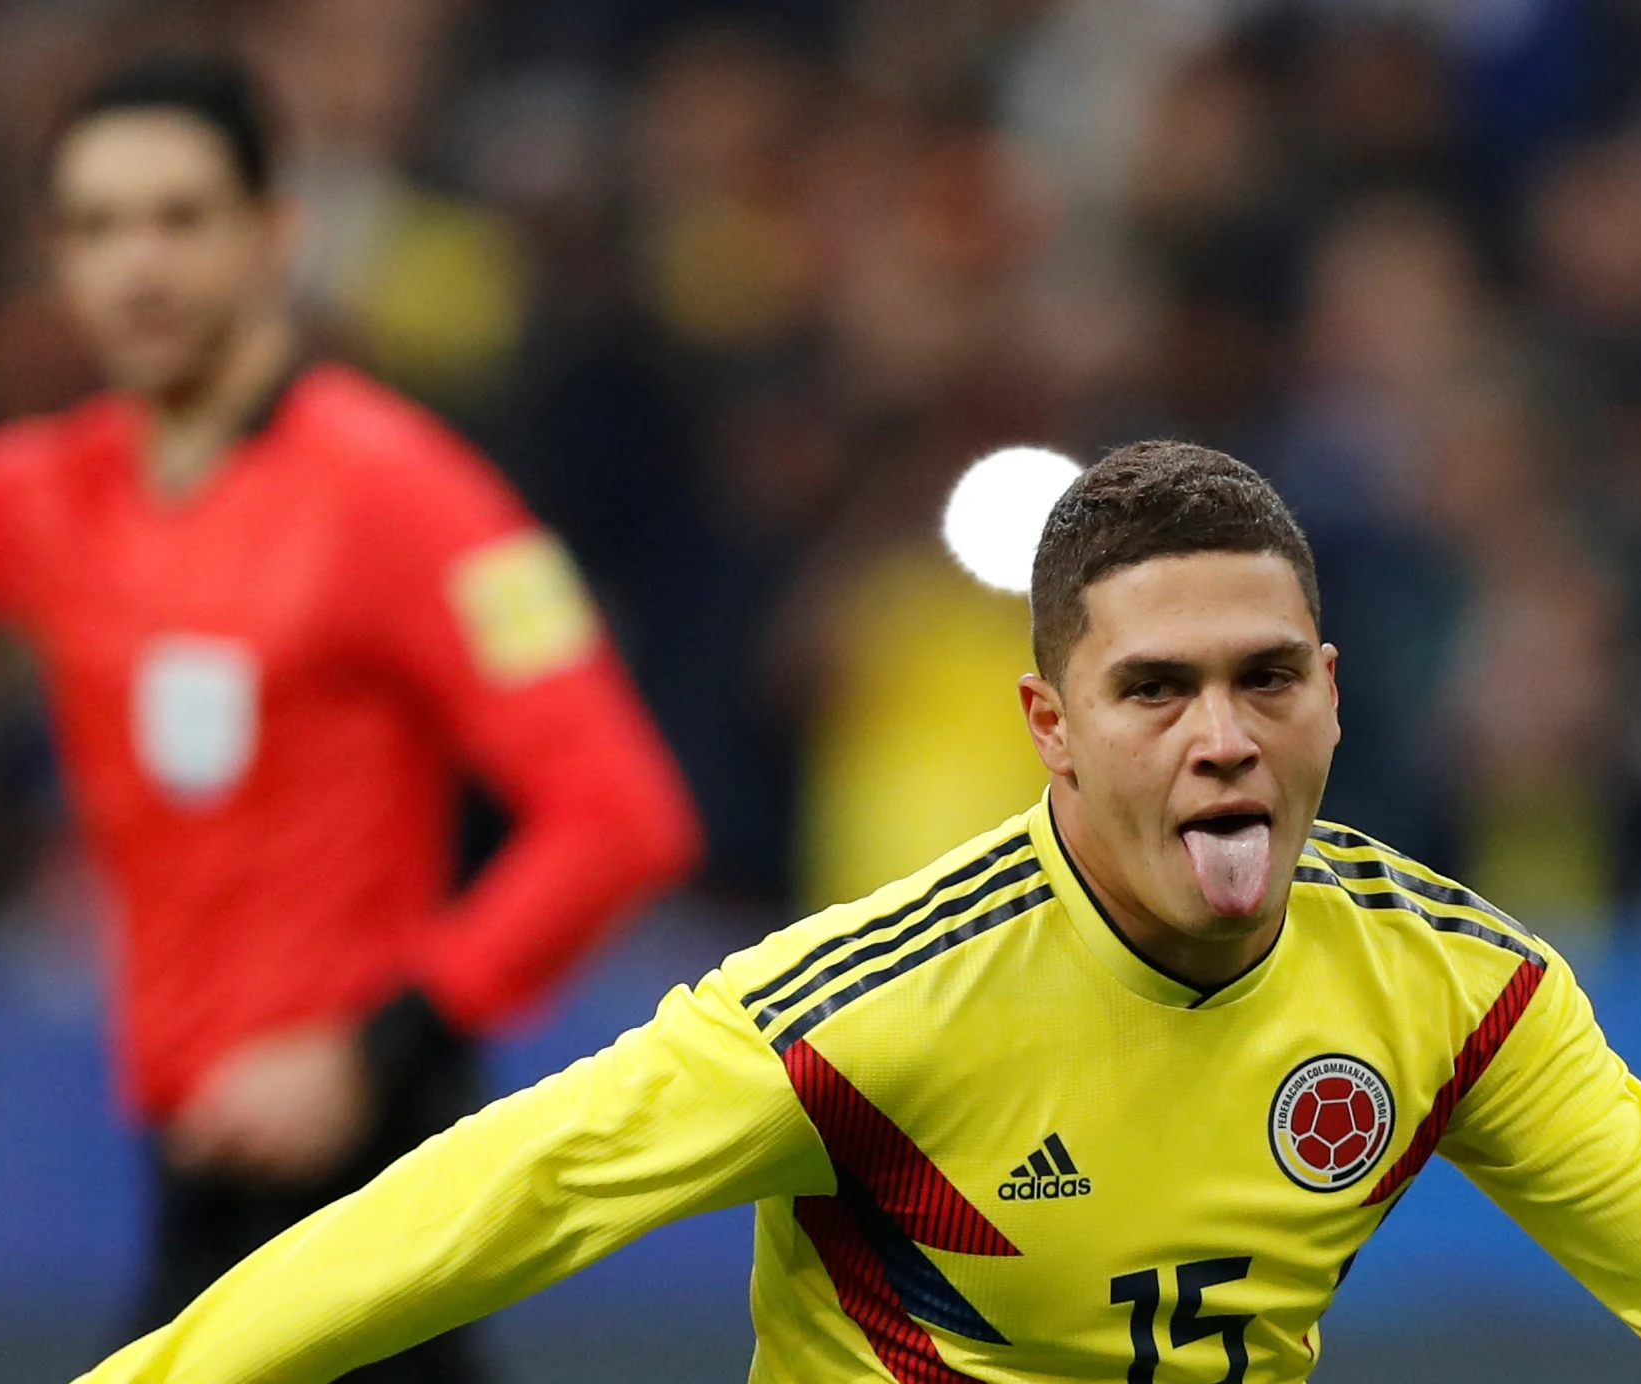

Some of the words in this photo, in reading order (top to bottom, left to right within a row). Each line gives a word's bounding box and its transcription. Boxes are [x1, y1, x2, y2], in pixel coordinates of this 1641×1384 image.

[1277, 1074, 1308, 1129] FEDERACION
[1307, 1062, 1366, 1082] COLOMBIANA
[1363, 1076, 1376, 1090] DE
[1371, 1086, 1387, 1121] FUTBOL
[998, 1176, 1091, 1200] adidas
